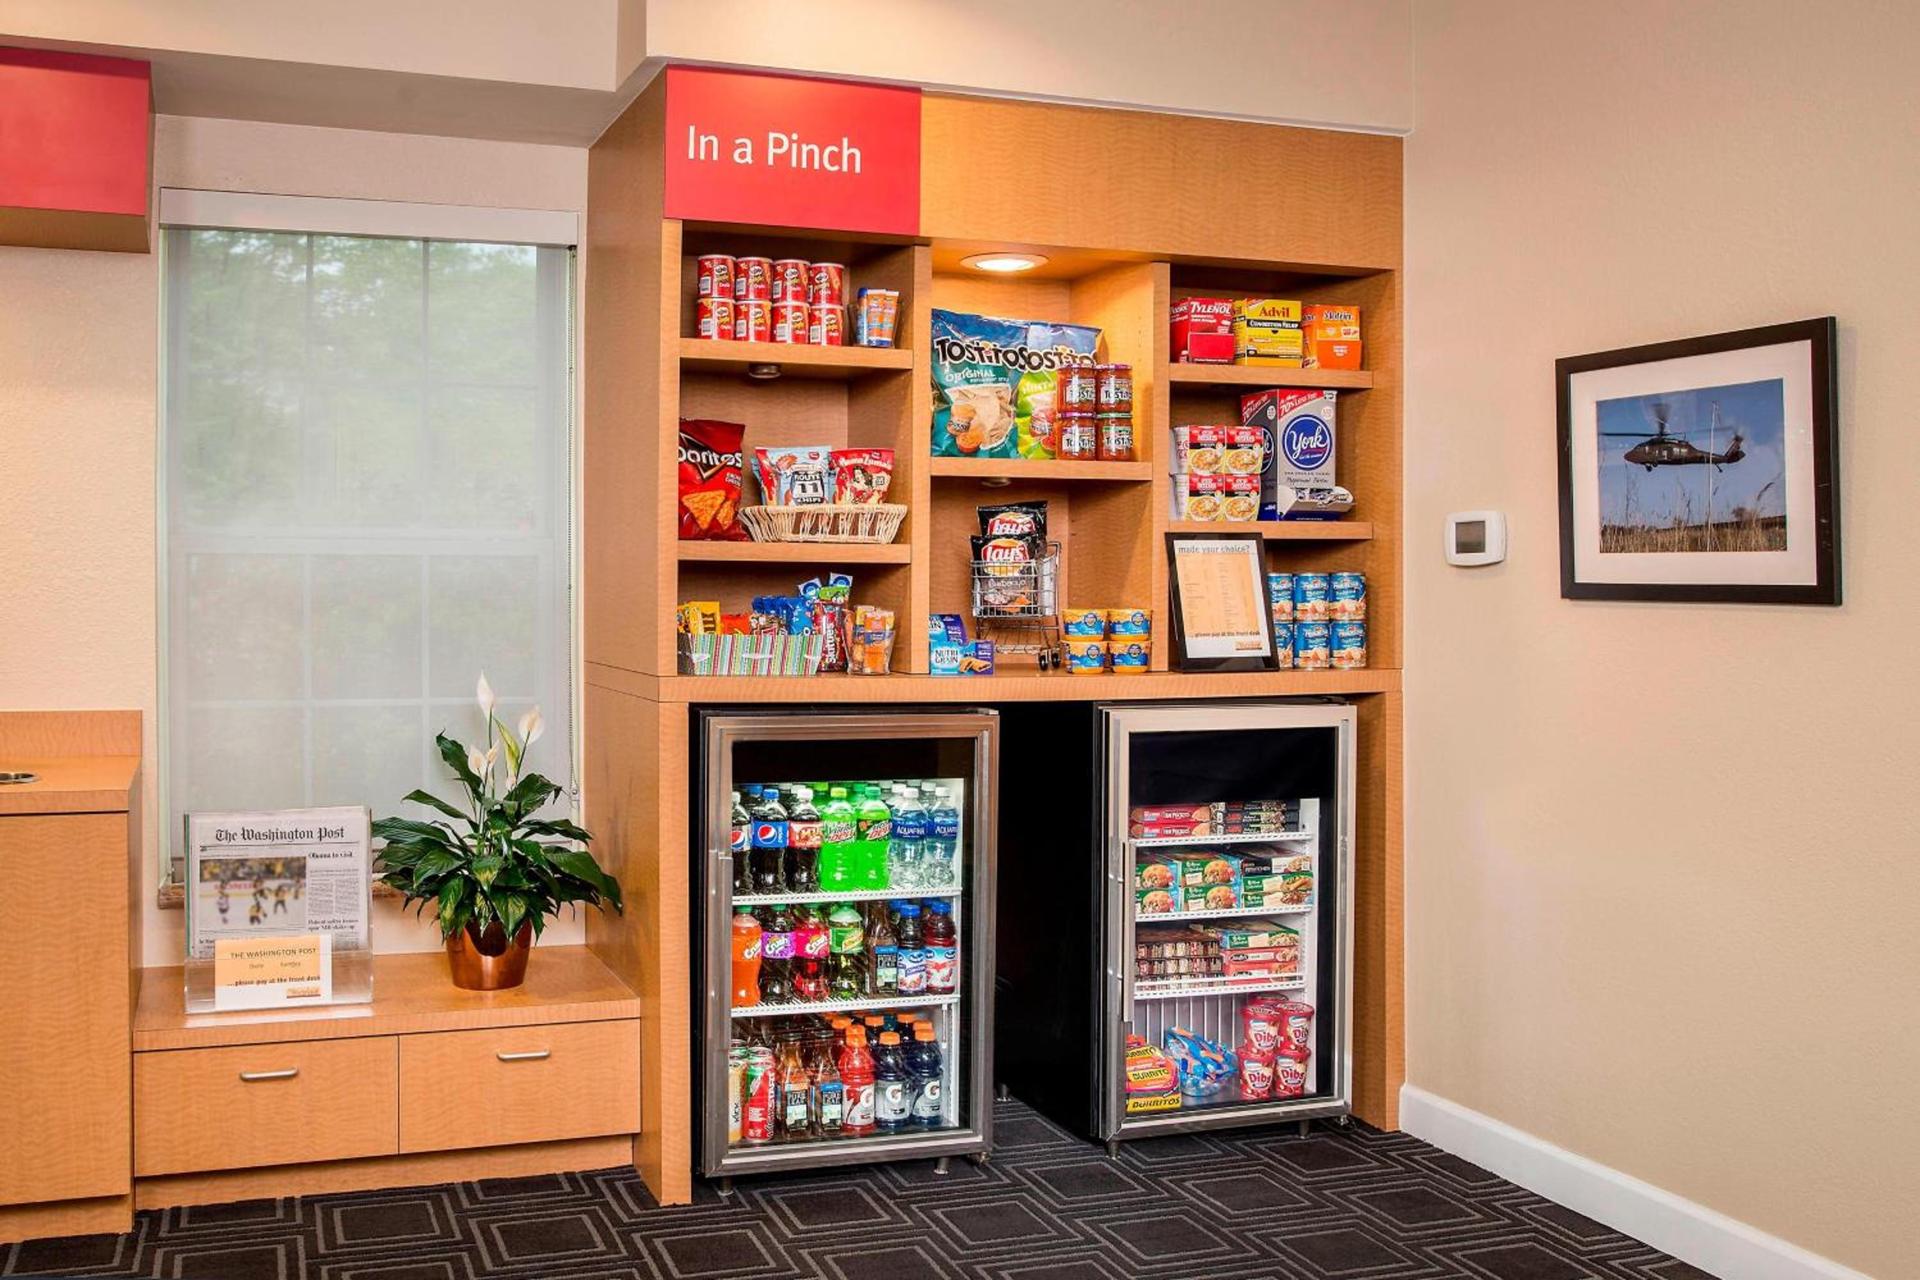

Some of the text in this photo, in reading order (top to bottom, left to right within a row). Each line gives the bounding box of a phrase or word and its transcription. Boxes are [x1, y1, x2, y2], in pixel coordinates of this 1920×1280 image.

[688, 125, 862, 174] In a Pinch
[1190, 301, 1232, 314] TYLENOL
[1259, 306, 1290, 318] Advil
[1289, 425, 1328, 459] York
[987, 545, 1025, 562] Lay's
[1178, 543, 1250, 554] made your choice?
[215, 826, 345, 844] The Washington Post
[230, 947, 317, 959] THE WASHINGTON POST
[1248, 1070, 1272, 1084] Dibs
[1281, 1067, 1305, 1080] Dibs
[886, 1084, 903, 1103] G
[925, 1080, 940, 1100] G
[1132, 1097, 1180, 1108] BURRITOS
